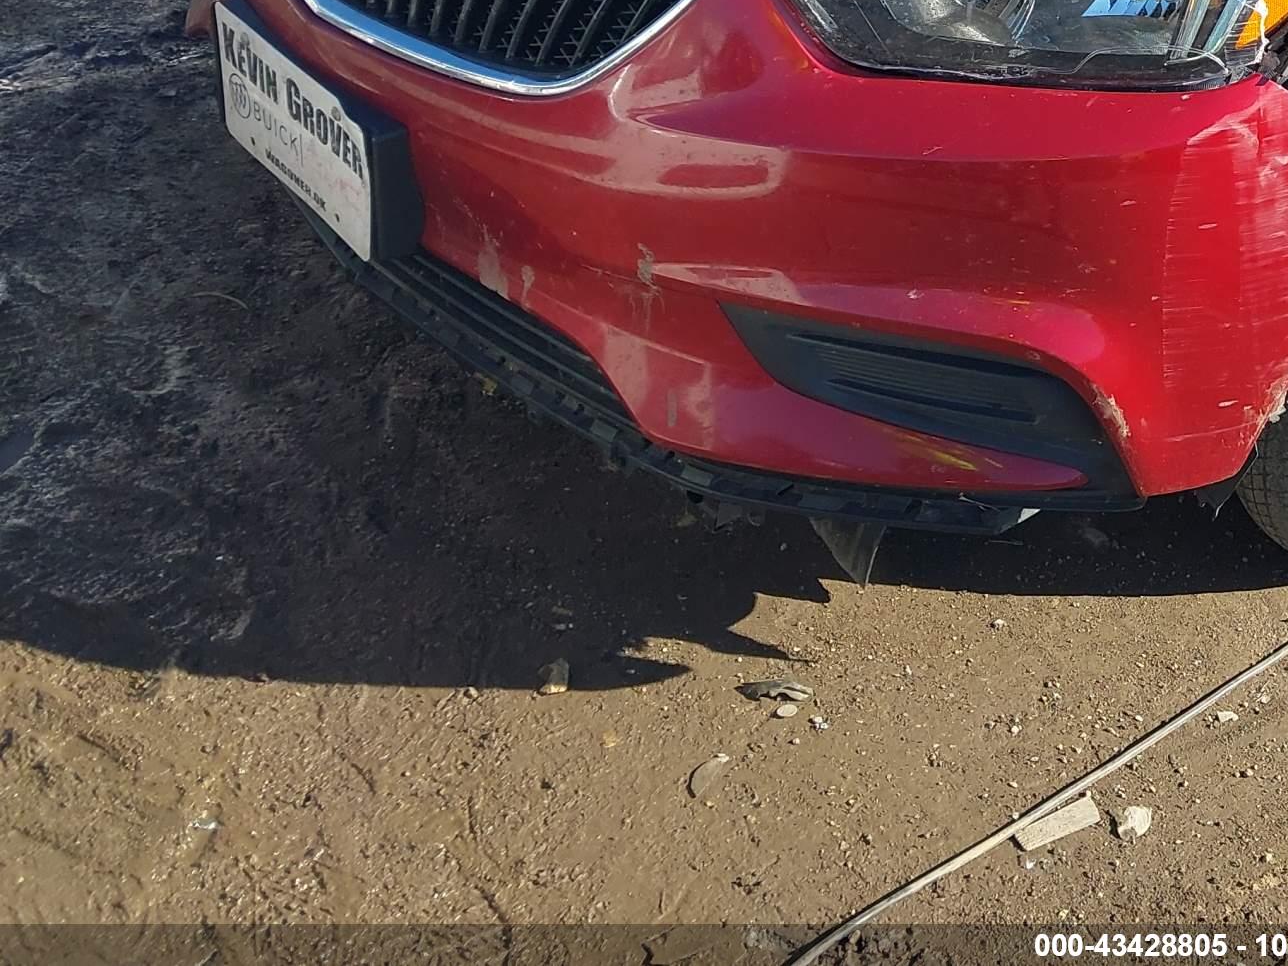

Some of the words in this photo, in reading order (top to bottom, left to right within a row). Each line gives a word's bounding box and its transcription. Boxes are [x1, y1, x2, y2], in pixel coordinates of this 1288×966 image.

[222, 21, 279, 105] KEVIN
[286, 77, 363, 180] GROVER
[252, 100, 299, 157] BUICK
